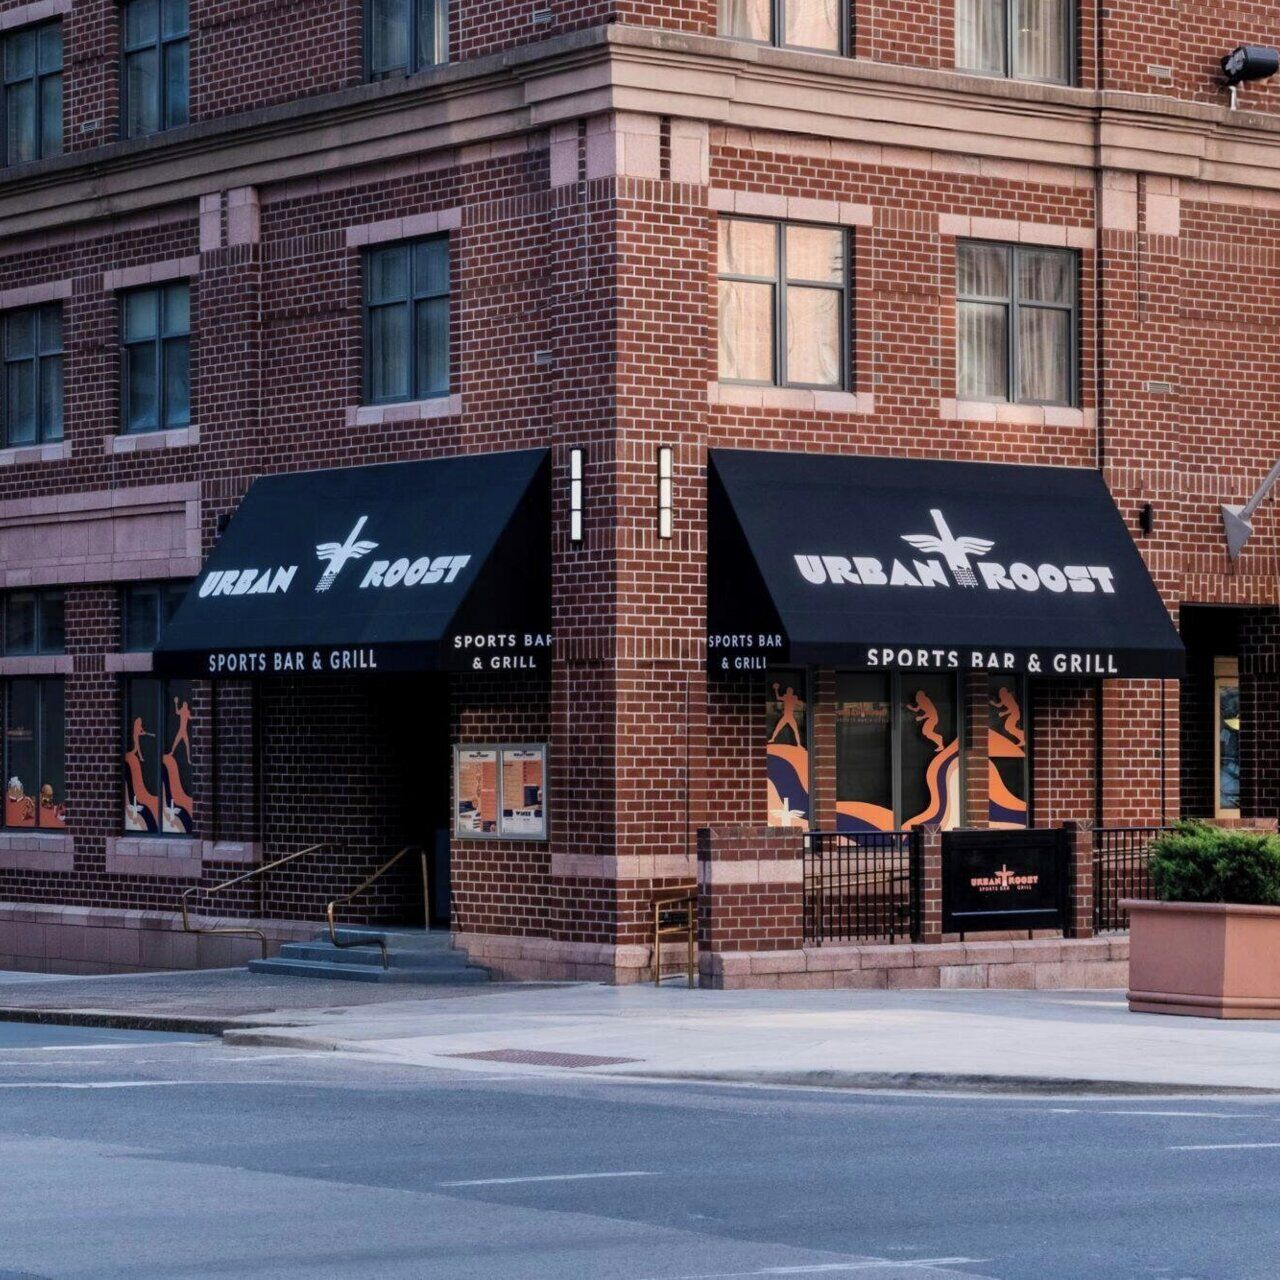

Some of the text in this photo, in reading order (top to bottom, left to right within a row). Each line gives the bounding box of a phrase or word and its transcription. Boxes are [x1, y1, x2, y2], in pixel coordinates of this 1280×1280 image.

[198, 555, 471, 598] URBAN ROOST
[793, 554, 1116, 593] URBAN ROOST
[454, 634, 516, 648] SPORTS
[708, 634, 782, 648] SPORTS BAR
[209, 649, 377, 671] SPORTS BAR & GRILL
[472, 656, 536, 670] & GRILL
[721, 656, 729, 669] &
[867, 647, 1118, 674] SPORTS BAR & GRILL
[970, 877, 1001, 886] URBAN
